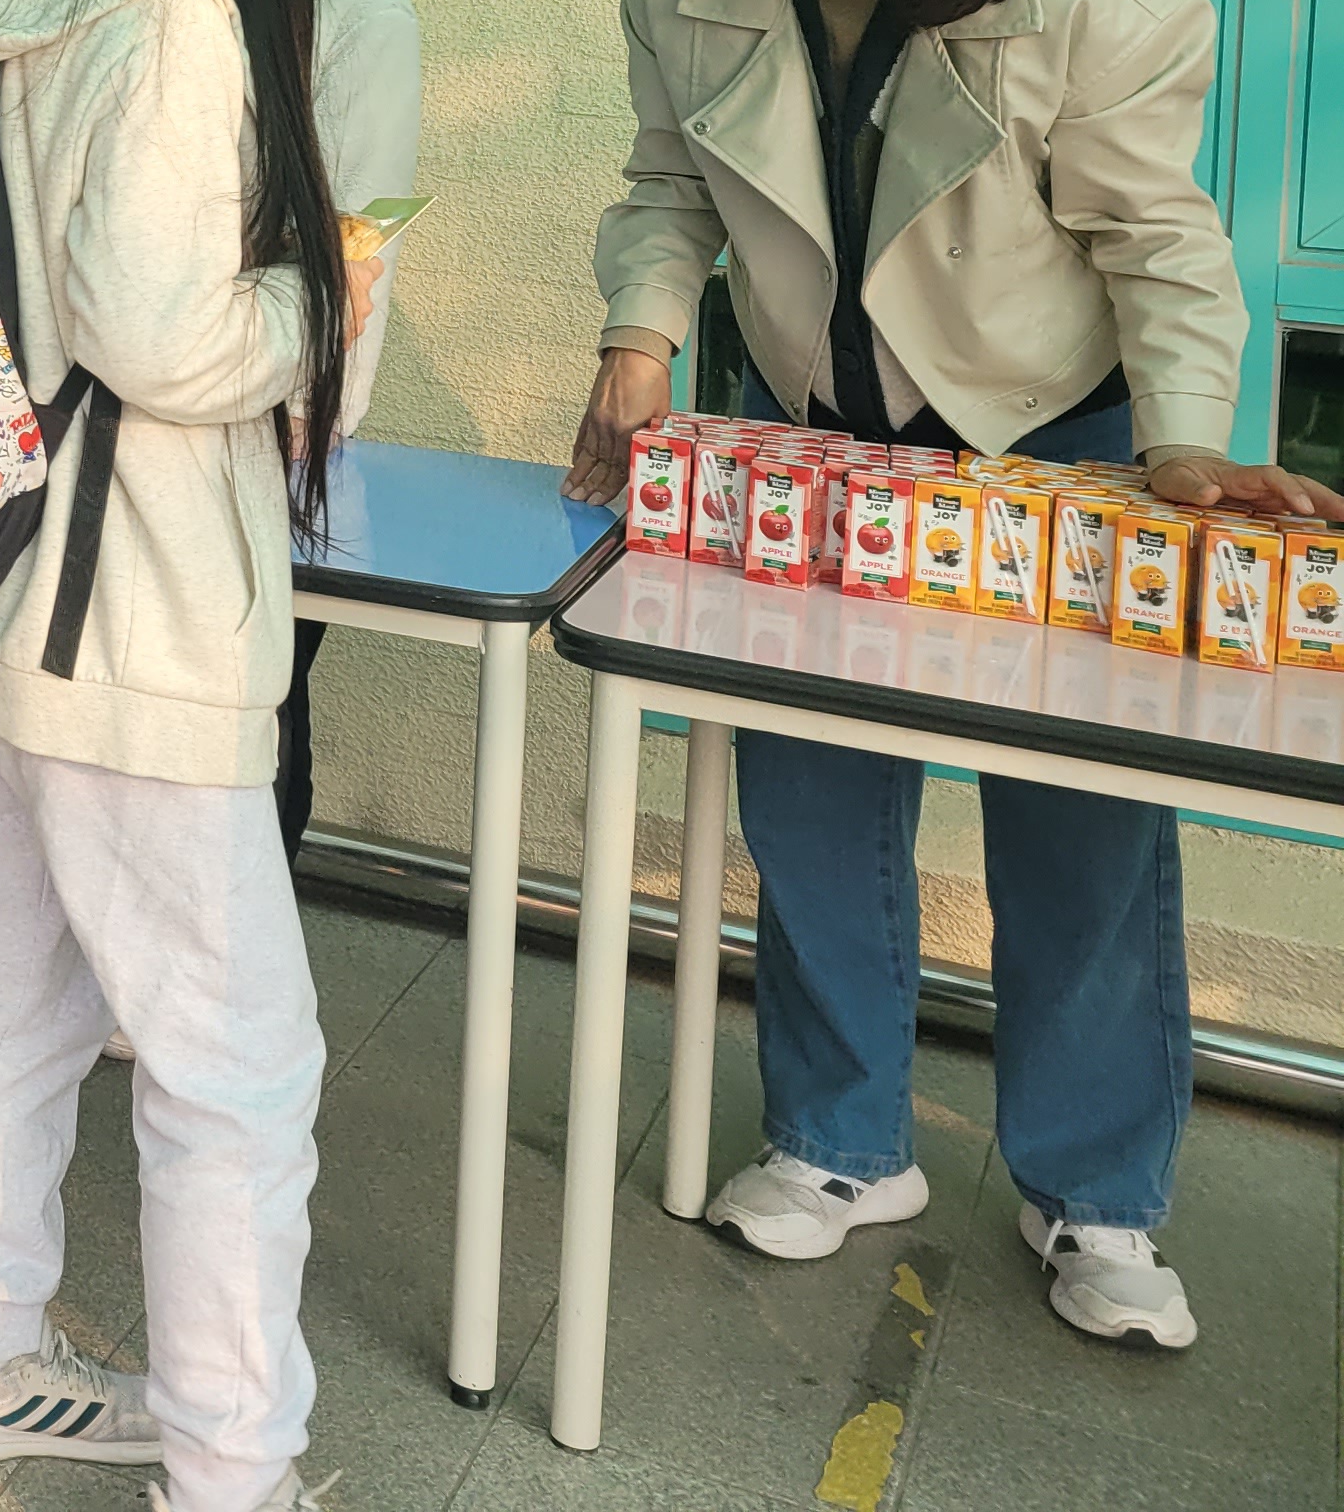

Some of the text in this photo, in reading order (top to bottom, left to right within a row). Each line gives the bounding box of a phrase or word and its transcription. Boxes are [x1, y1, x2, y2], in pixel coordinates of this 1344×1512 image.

[648, 462, 671, 472] JOY
[767, 489, 791, 500] JOY
[866, 502, 892, 513] JOY
[640, 516, 673, 528] APPLE
[933, 510, 959, 522] JOY
[760, 546, 793, 558] APPLE
[1137, 547, 1164, 559] JOY
[858, 559, 894, 571] APPLE
[1306, 563, 1336, 575] JOY
[920, 568, 967, 581] ORANGE
[1124, 606, 1172, 622] ORANGE
[1292, 625, 1344, 639] ORANGE
